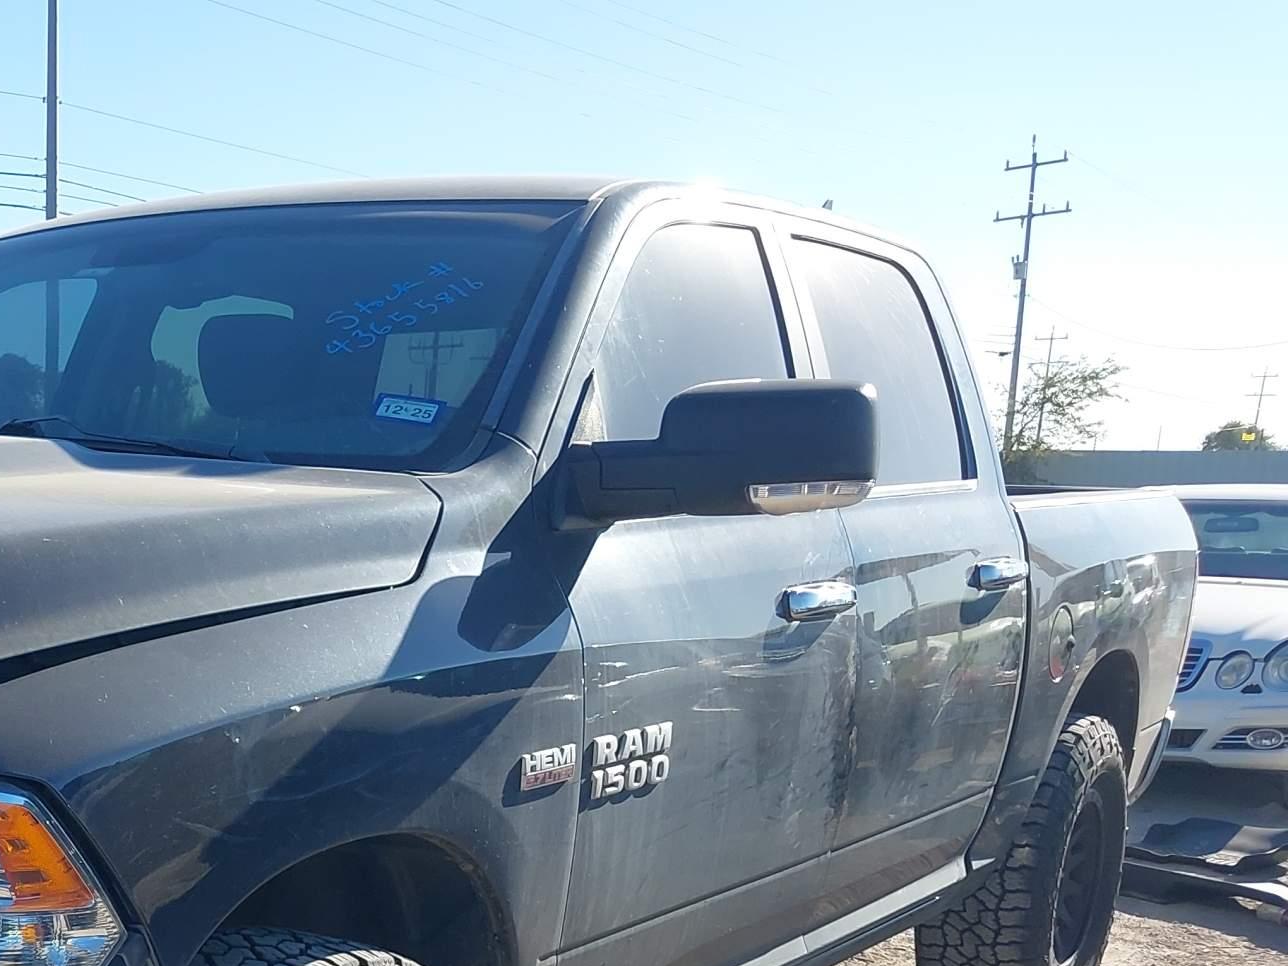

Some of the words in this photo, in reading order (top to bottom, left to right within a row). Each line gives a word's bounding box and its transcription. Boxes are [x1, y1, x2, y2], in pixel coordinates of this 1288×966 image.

[325, 277, 485, 356] 43655816
[383, 403, 404, 415] 12
[410, 407, 433, 419] 25
[522, 743, 577, 775] HEMI
[593, 721, 674, 766] RAM
[591, 754, 671, 800] 1500
